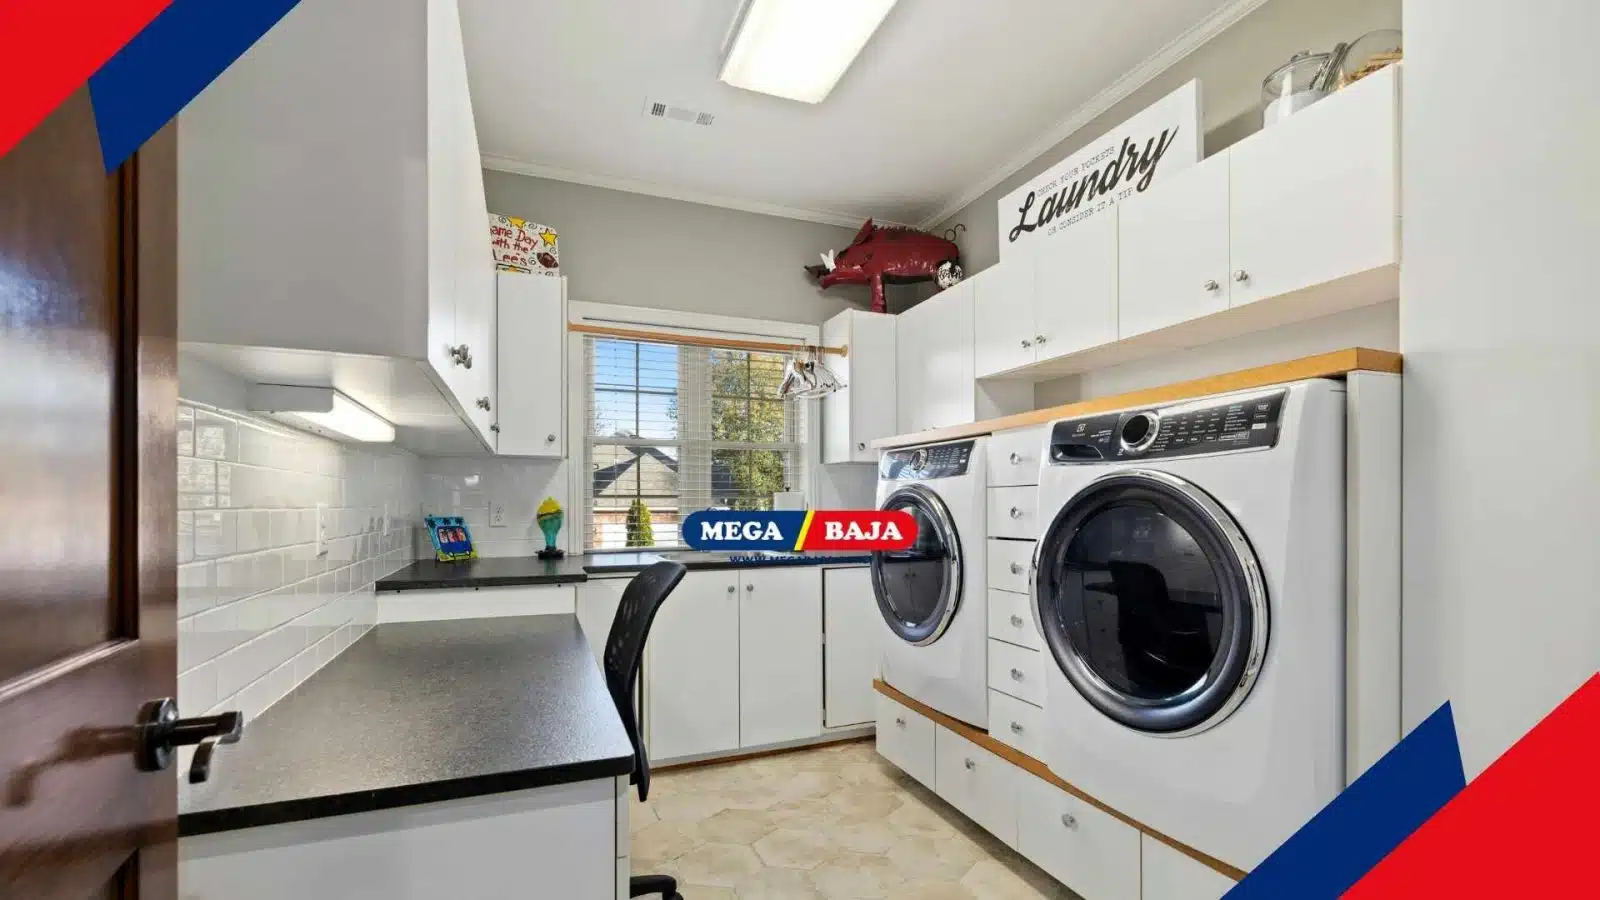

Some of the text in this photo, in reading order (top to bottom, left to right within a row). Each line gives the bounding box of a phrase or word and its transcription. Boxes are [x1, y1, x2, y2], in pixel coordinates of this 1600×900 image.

[1061, 167, 1079, 184] YOUR
[1081, 146, 1116, 171] POCKETS
[1009, 125, 1179, 242] Laundry
[1059, 207, 1095, 230] CONSIDER
[490, 226, 539, 250] ame Day
[492, 238, 529, 254] ith the
